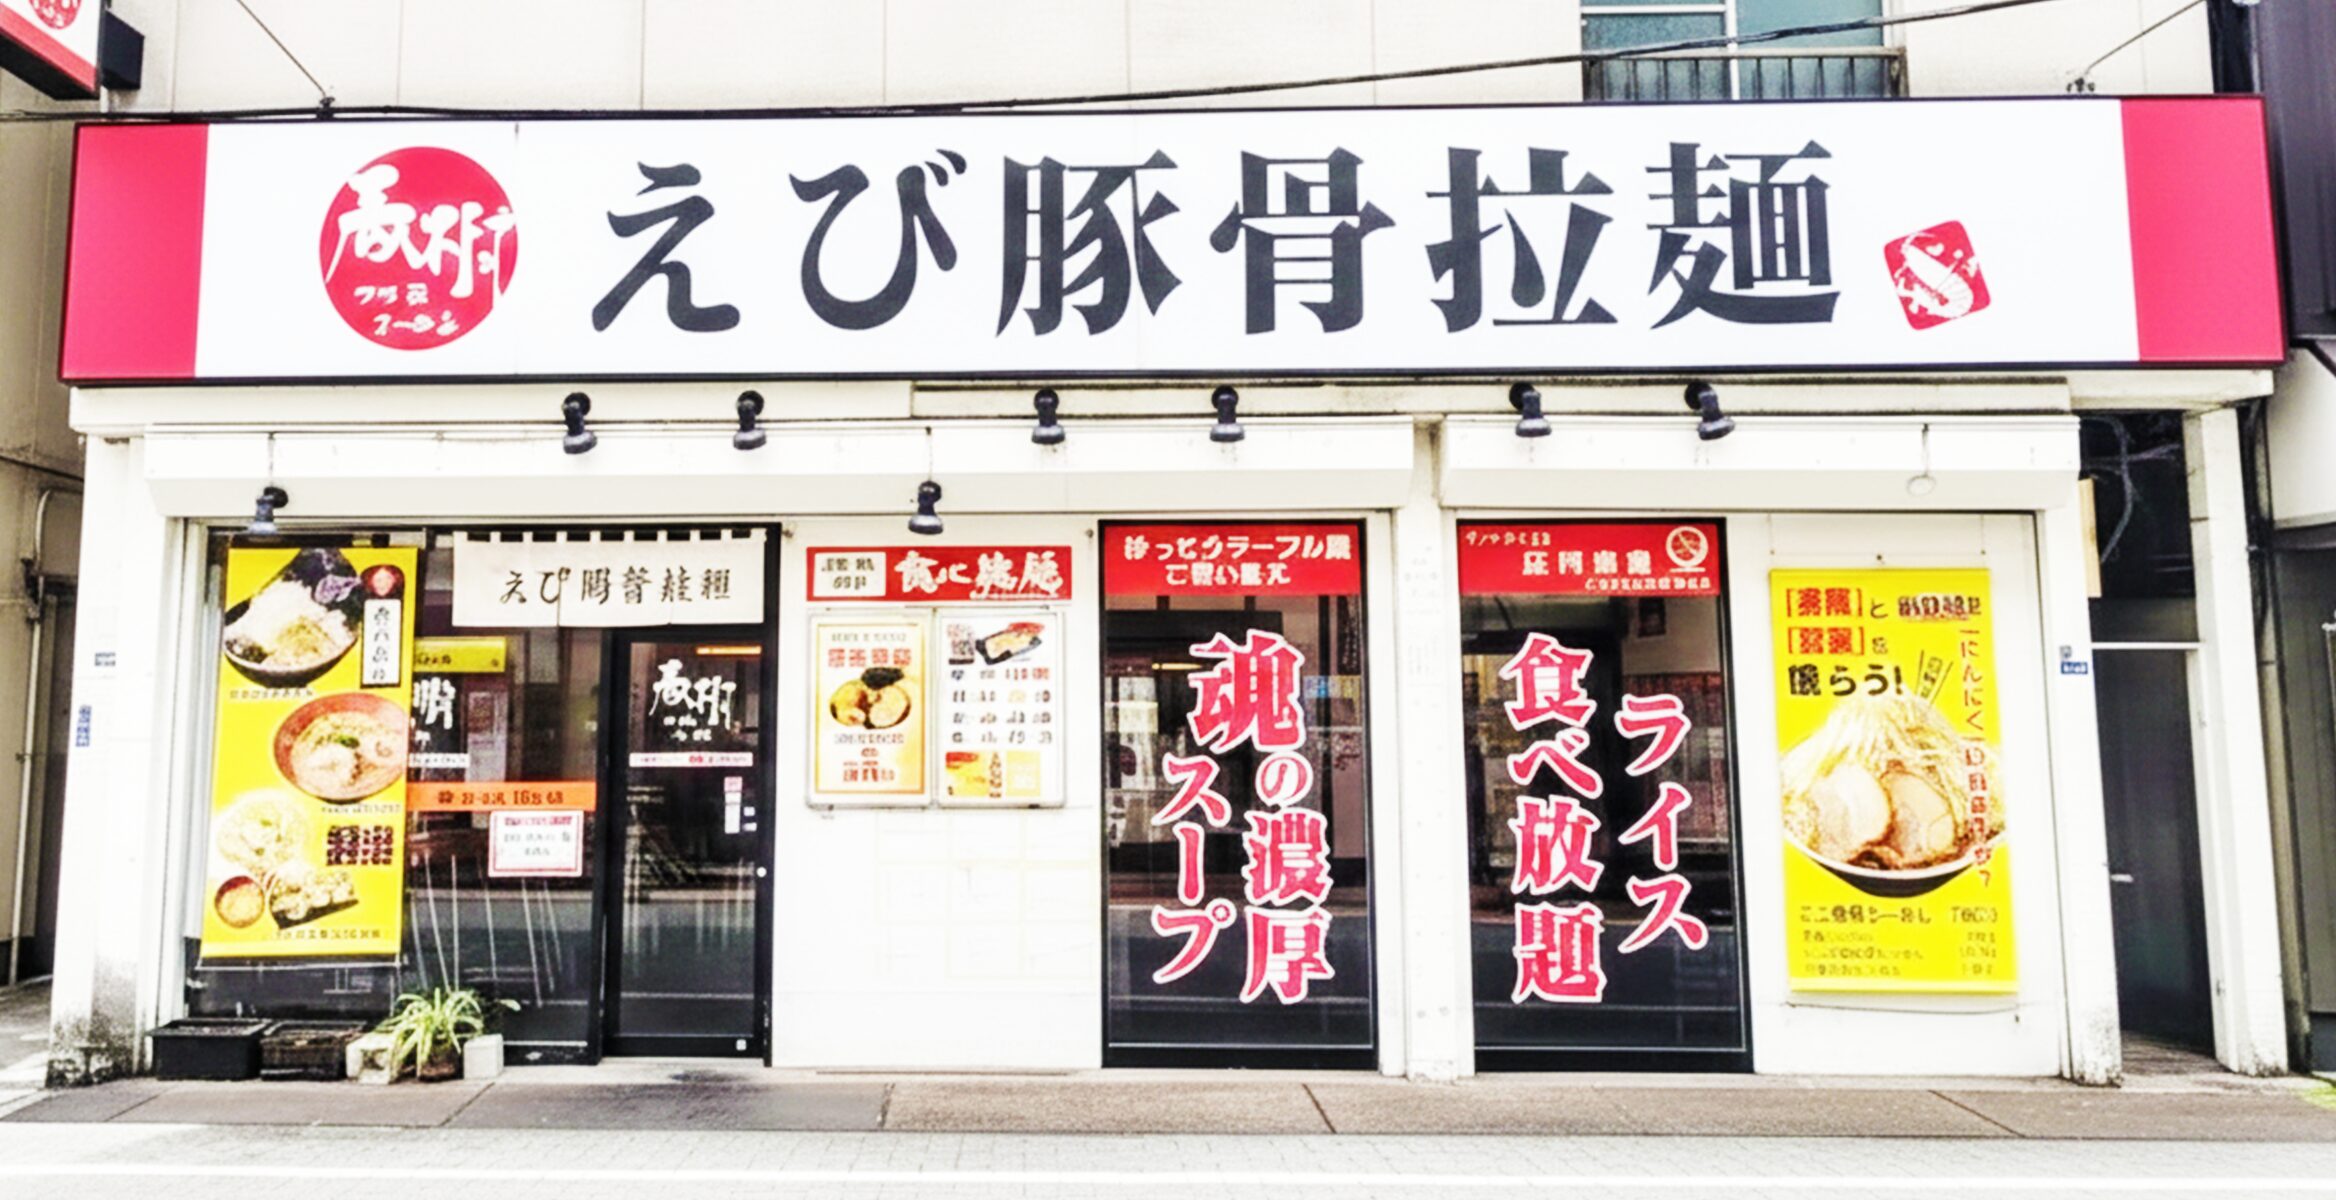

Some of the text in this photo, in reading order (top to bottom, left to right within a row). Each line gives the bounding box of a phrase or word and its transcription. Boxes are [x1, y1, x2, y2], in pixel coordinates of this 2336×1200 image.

[592, 140, 1841, 337] えび豚骨拉麺
[1151, 751, 1237, 985] スープ
[1188, 628, 1335, 1005] 魂の濃厚
[1500, 632, 1608, 1004] 食べ放題
[1614, 693, 1710, 953] ライス
